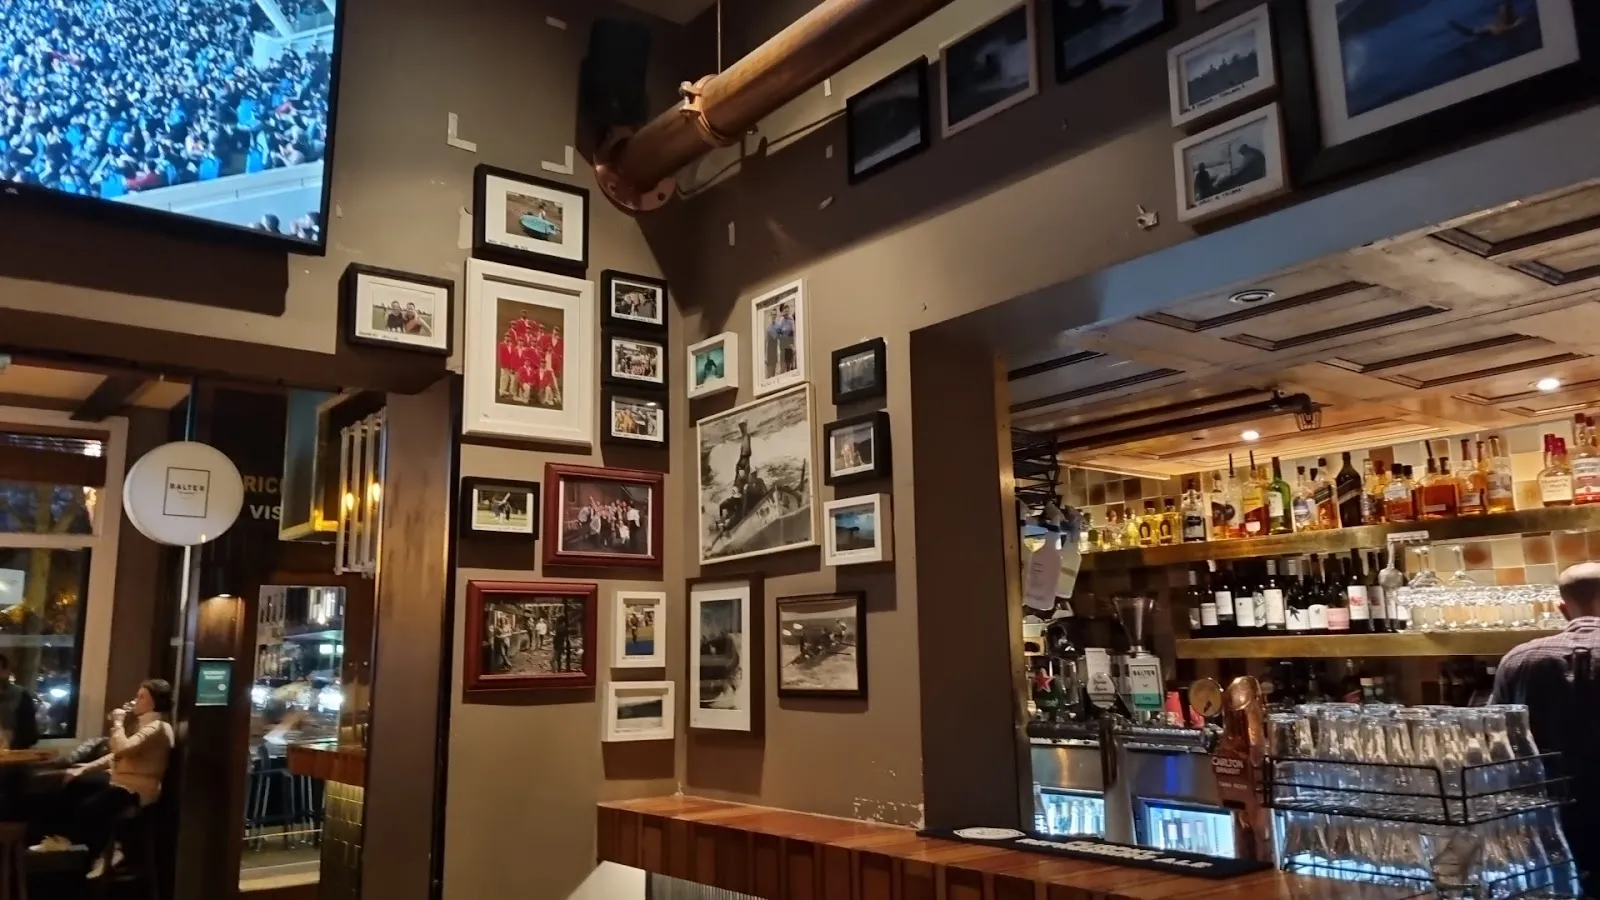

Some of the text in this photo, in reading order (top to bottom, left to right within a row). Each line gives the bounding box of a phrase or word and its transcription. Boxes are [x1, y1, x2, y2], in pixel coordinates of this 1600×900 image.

[169, 483, 205, 492] BALTER
[243, 475, 283, 494] RIC
[1132, 669, 1155, 677] BALTER
[1211, 756, 1244, 769] CARLTON
